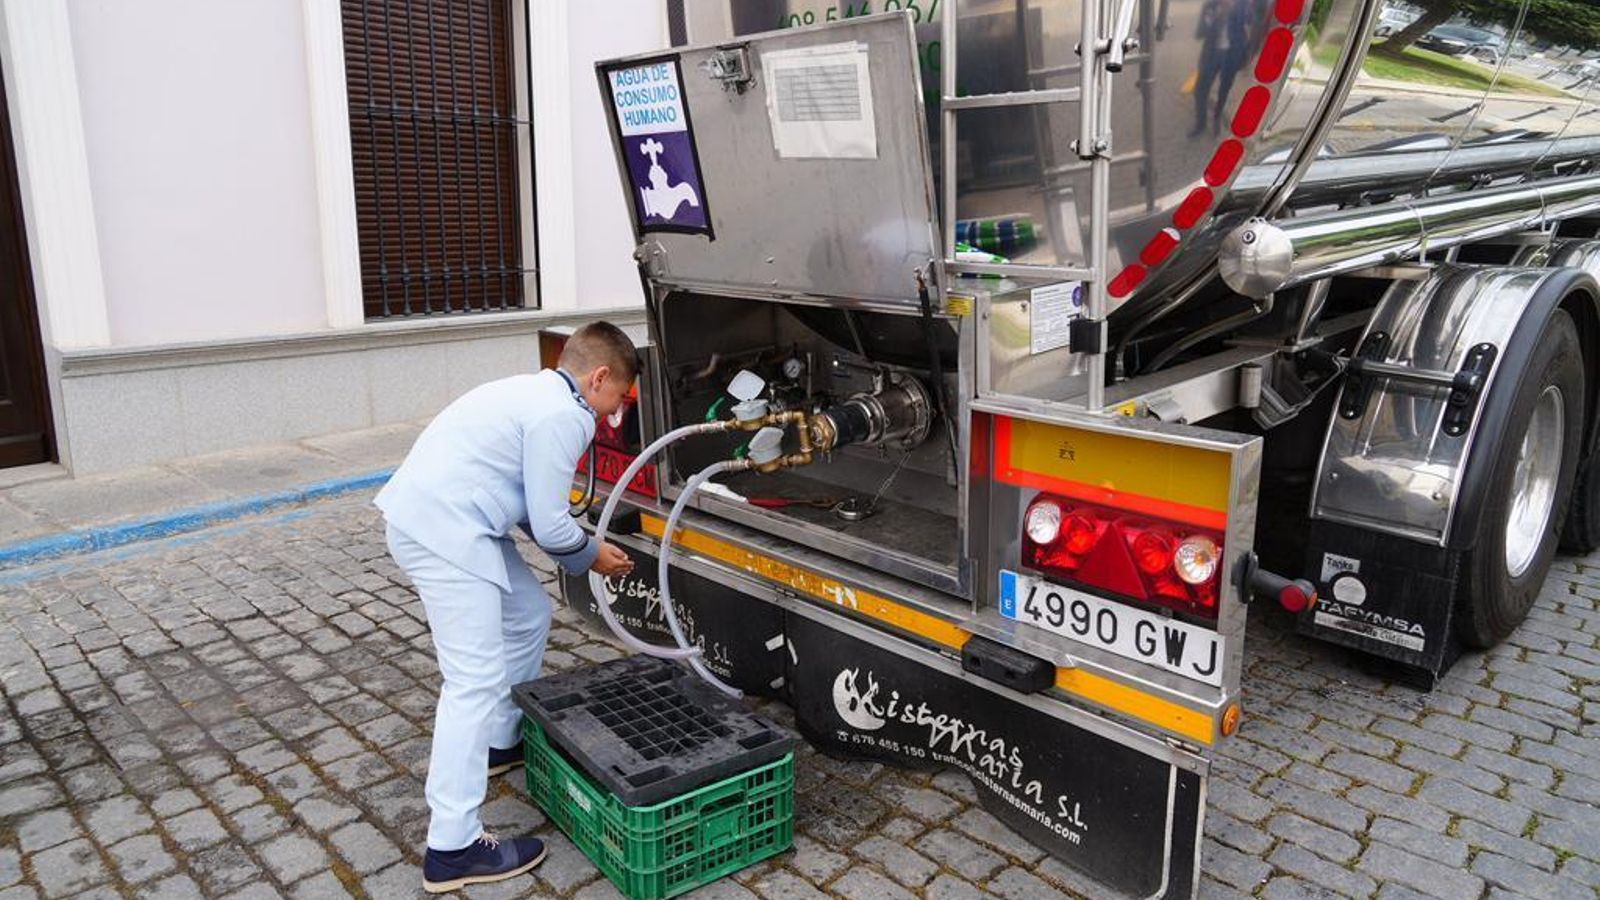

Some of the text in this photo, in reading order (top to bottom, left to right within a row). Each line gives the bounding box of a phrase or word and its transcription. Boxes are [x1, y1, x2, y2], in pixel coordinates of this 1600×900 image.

[616, 63, 670, 87] AGUA DE
[616, 84, 677, 107] CONSUMO
[624, 106, 677, 126] HUMANO
[1004, 599, 1012, 609] E
[1024, 586, 1219, 677] 4990 GWJ
[902, 745, 926, 758] 150
[1057, 795, 1089, 832] S.L.
